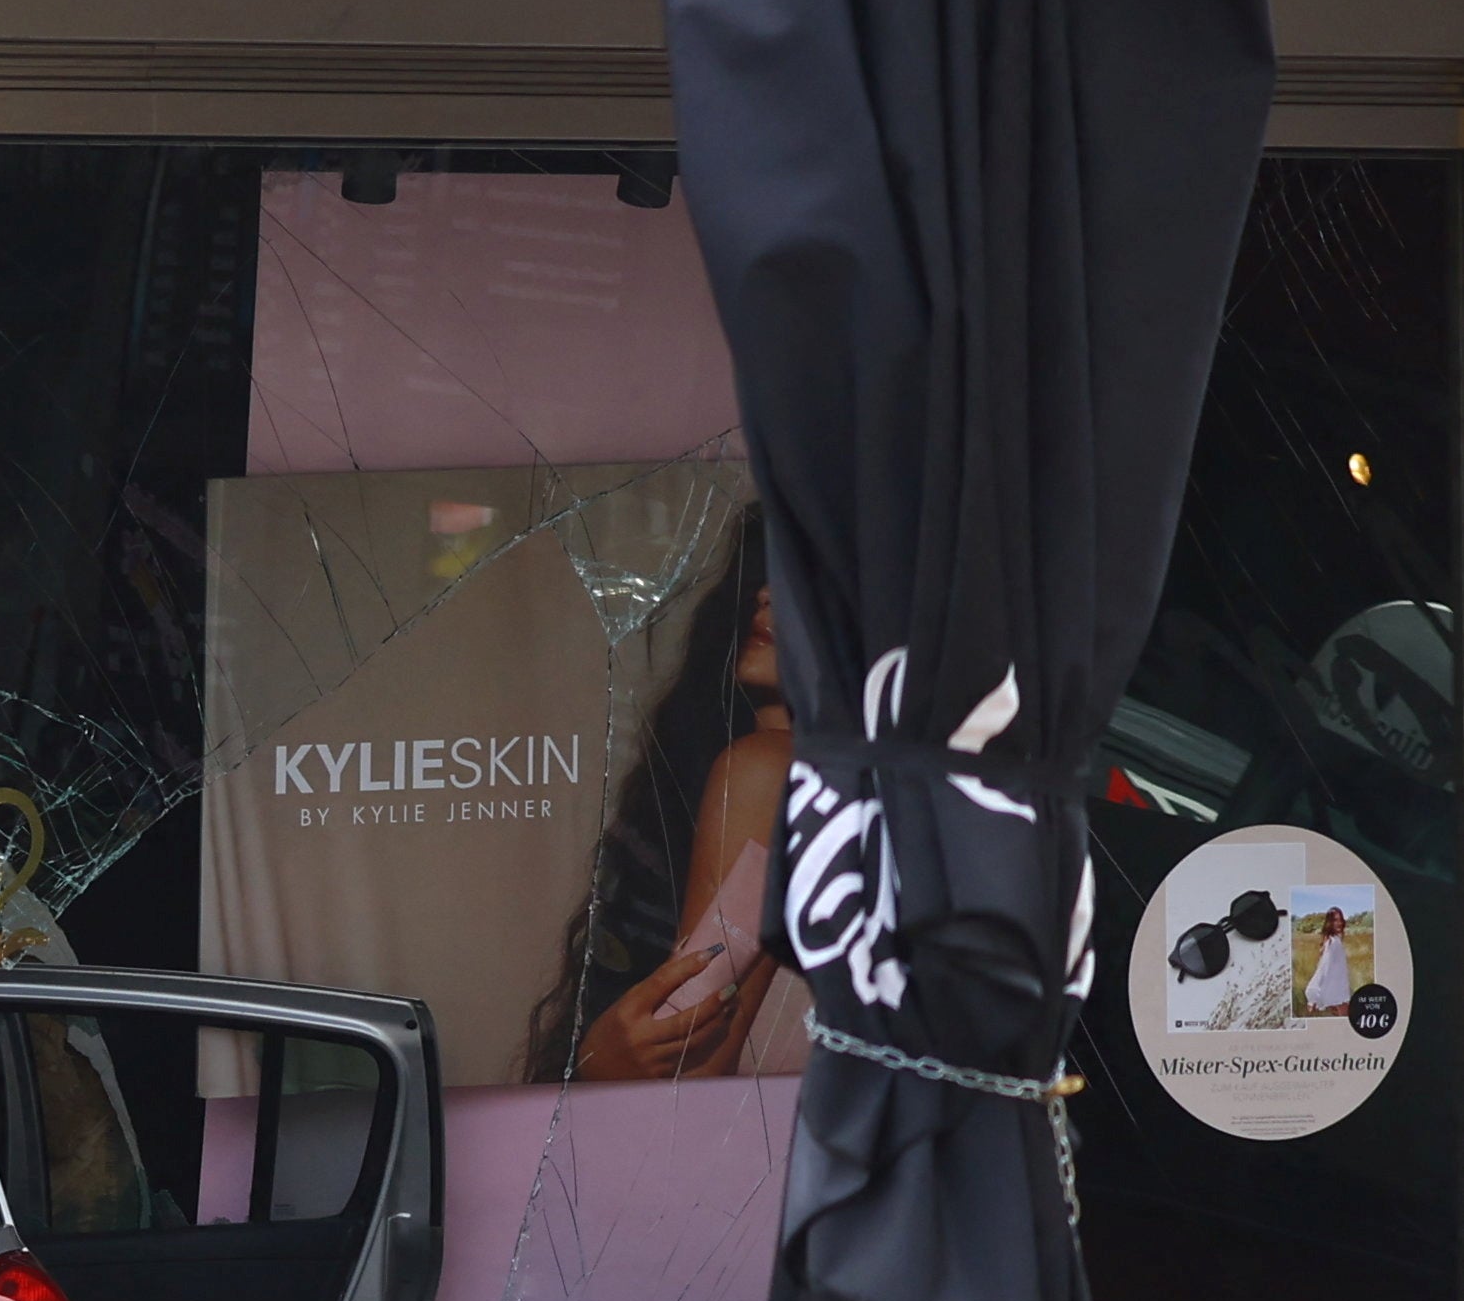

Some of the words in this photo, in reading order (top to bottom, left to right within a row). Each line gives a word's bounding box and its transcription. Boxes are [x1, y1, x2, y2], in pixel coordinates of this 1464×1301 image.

[275, 734, 579, 795] KYLIESKIN
[300, 808, 330, 827] BY
[352, 804, 425, 825] KYLIE
[447, 800, 553, 822] JENNER
[1159, 1052, 1385, 1078] Mister-Spex-Gutschein
